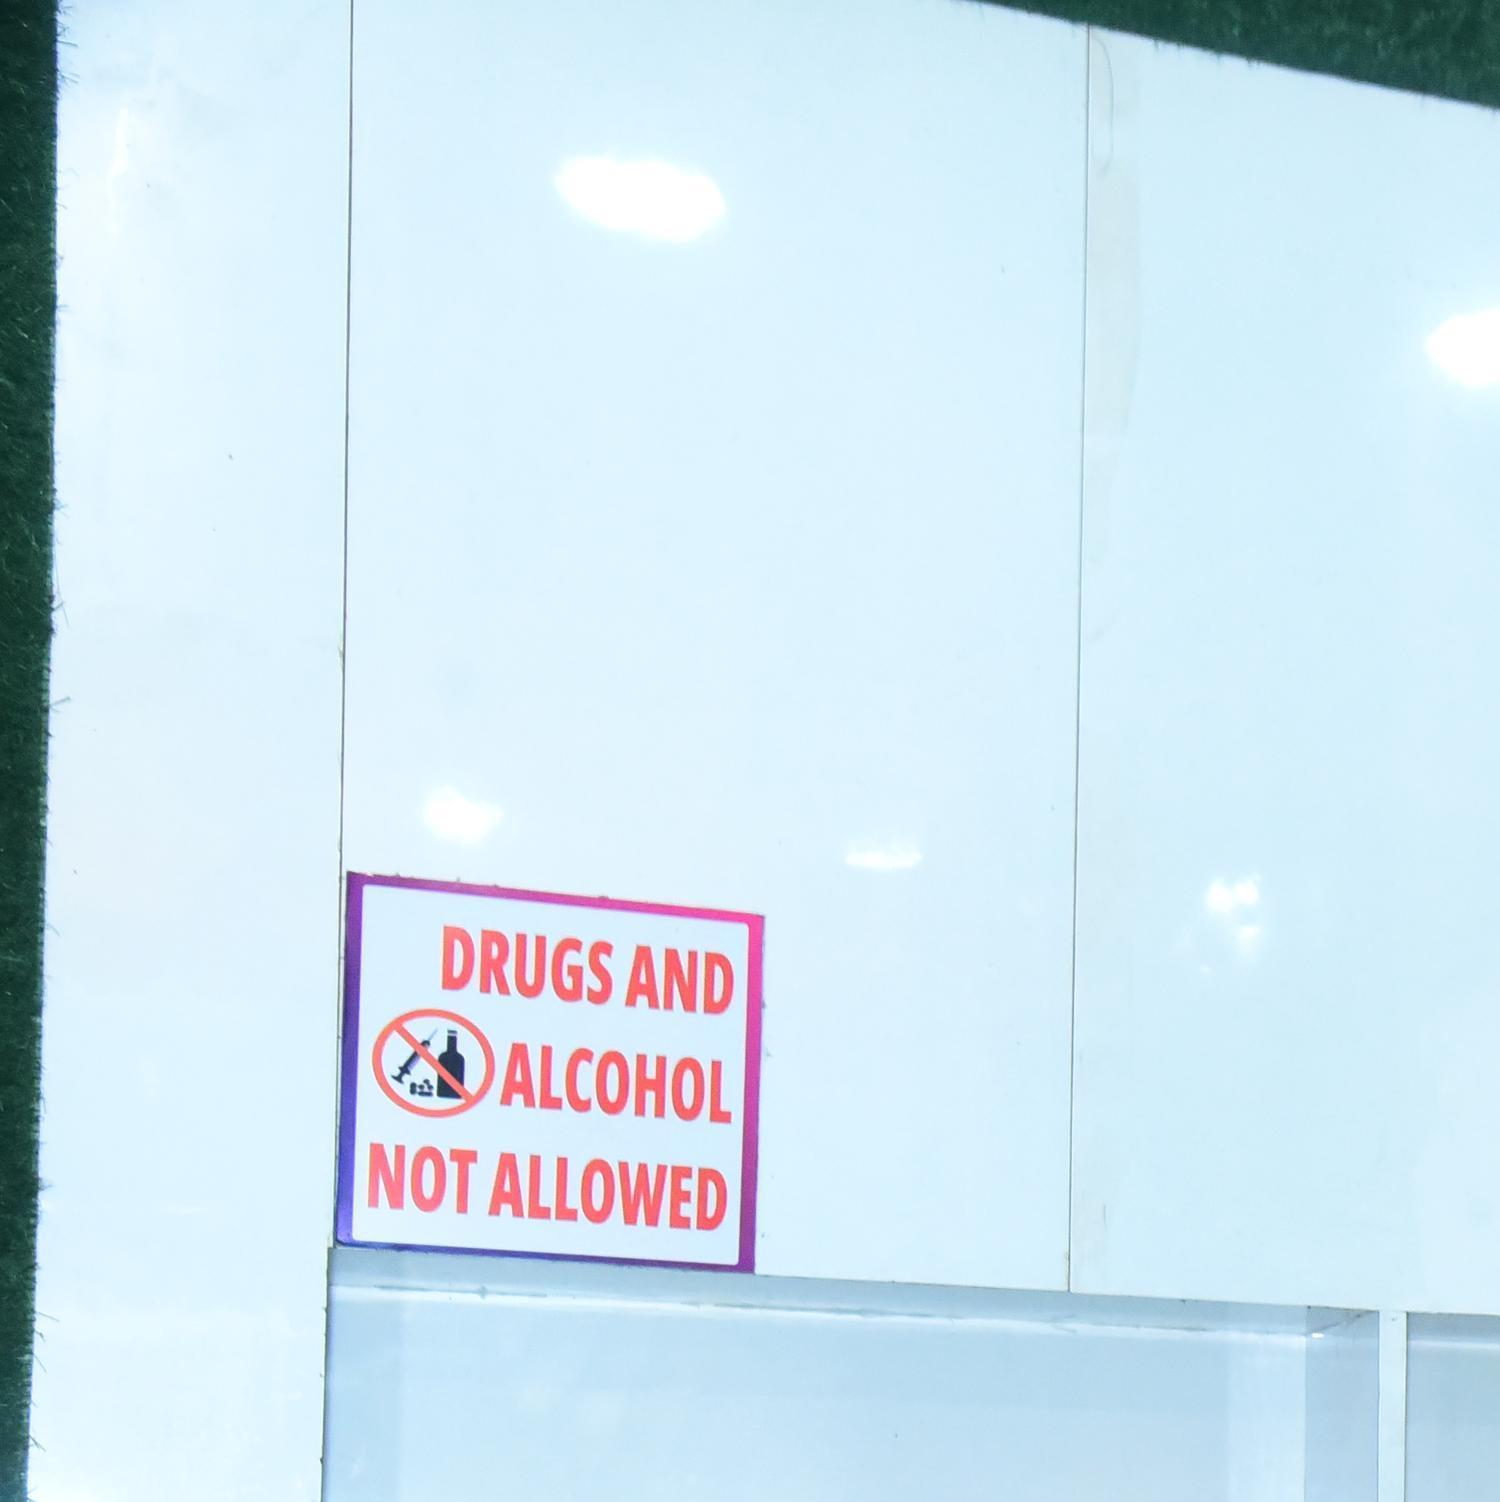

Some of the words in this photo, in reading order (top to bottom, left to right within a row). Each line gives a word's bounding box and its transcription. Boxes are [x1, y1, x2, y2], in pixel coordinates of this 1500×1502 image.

[441, 925, 614, 1006] DRUGS
[625, 944, 735, 1015] AND
[500, 1043, 732, 1124] ALCOHOL
[368, 1142, 478, 1215] NOT
[488, 1152, 728, 1231] ALLOWED
